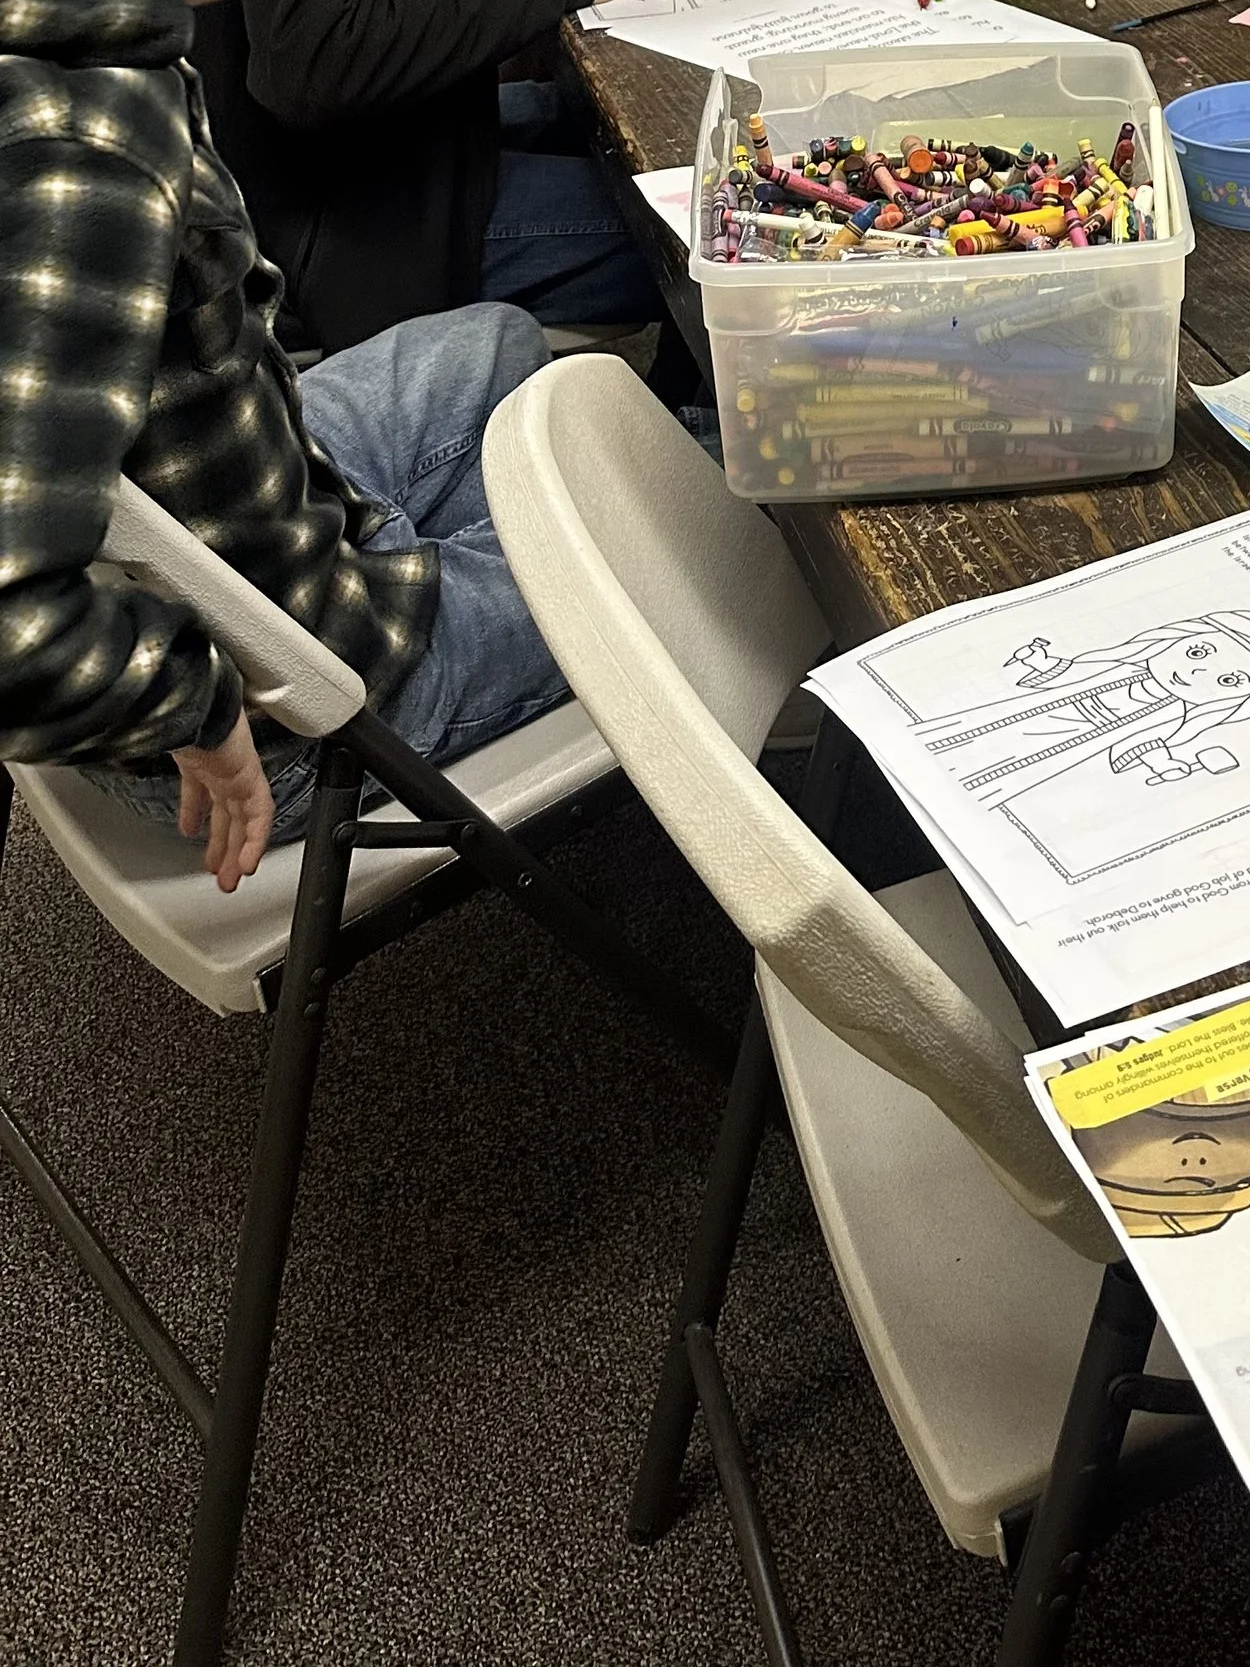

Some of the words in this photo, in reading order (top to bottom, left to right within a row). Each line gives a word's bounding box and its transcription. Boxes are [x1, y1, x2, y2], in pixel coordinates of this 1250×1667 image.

[1221, 546, 1234, 556] the
[1211, 872, 1231, 886] job
[1232, 870, 1244, 881] of
[1183, 881, 1211, 896] God
[1201, 887, 1228, 902] God
[1152, 888, 1182, 903] gave
[1138, 900, 1152, 908] to
[1159, 900, 1187, 913] help
[1130, 909, 1159, 922] them
[1107, 919, 1130, 932] talk
[1086, 927, 1105, 938] out
[1058, 933, 1085, 946] their
[1132, 1049, 1163, 1065] Judges
[1216, 1074, 1250, 1092] Verse
